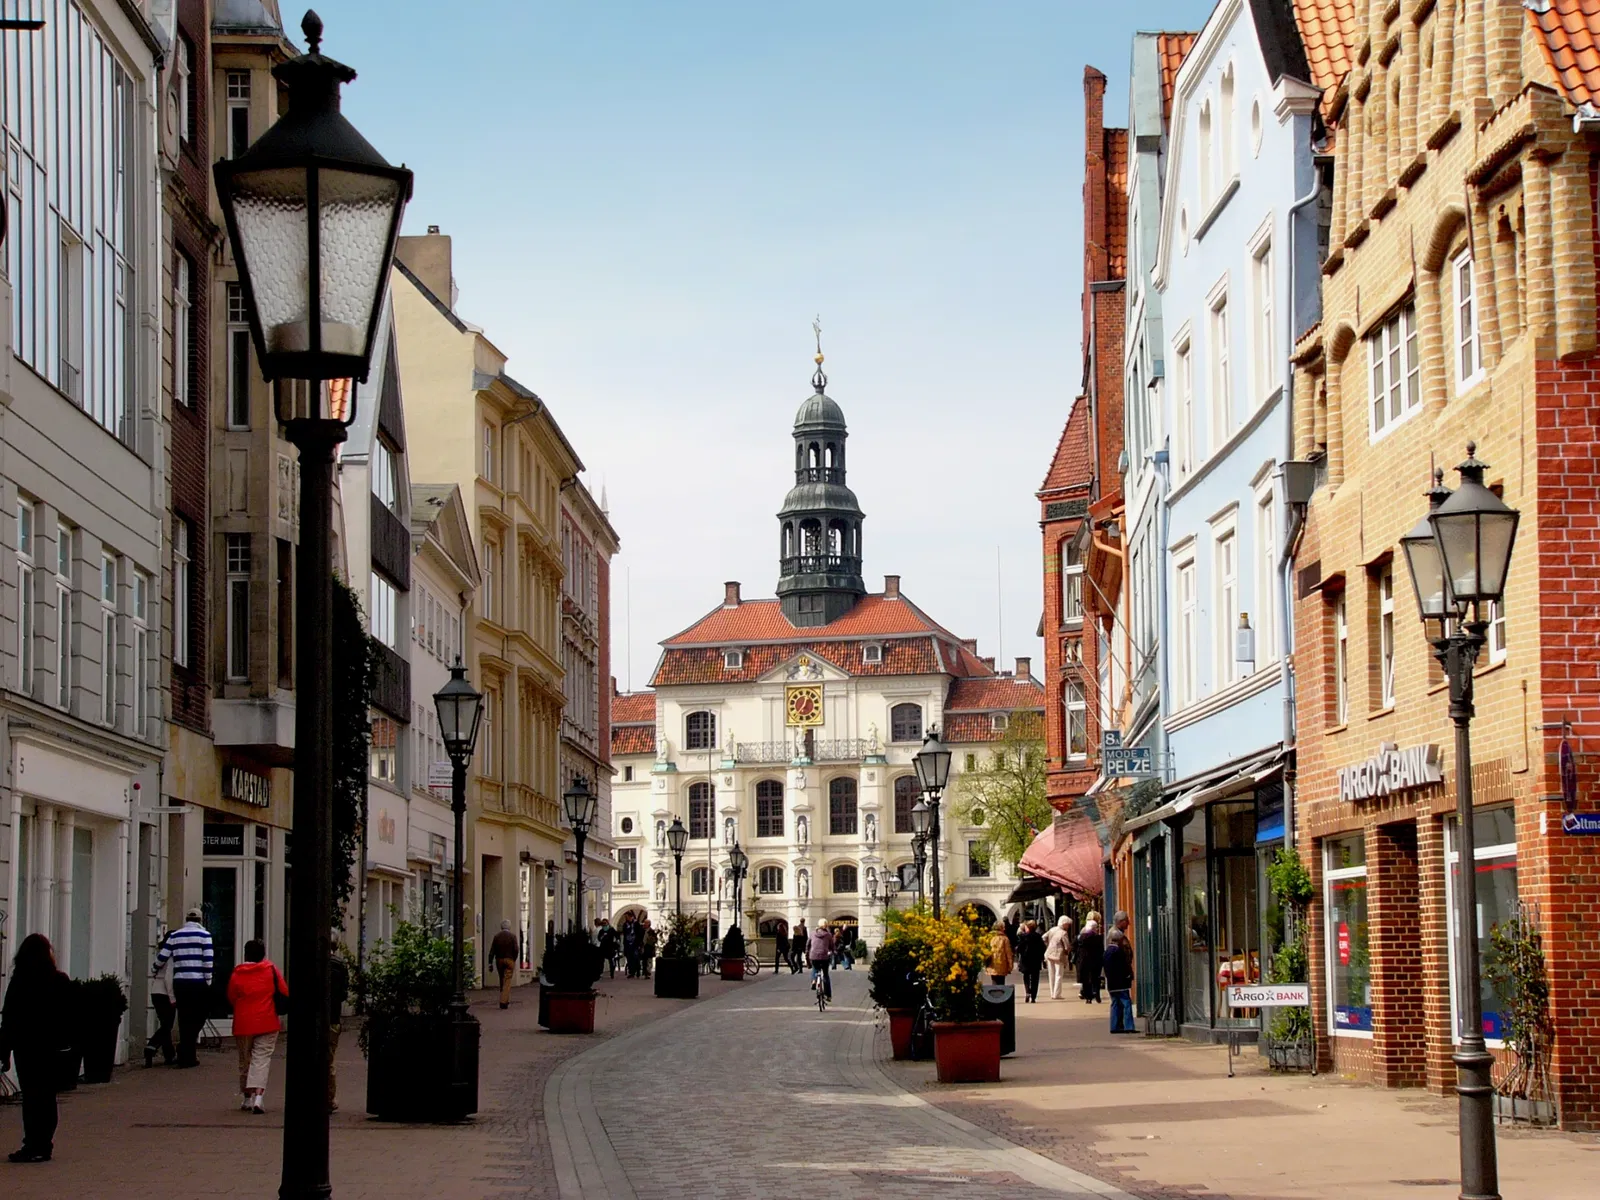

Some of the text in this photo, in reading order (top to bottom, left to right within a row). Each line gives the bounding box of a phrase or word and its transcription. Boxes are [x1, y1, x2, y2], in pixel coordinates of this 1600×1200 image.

[1106, 749, 1150, 759] MODE &
[1107, 760, 1151, 774] PELZE
[1231, 992, 1305, 1001] TARGO BANK
